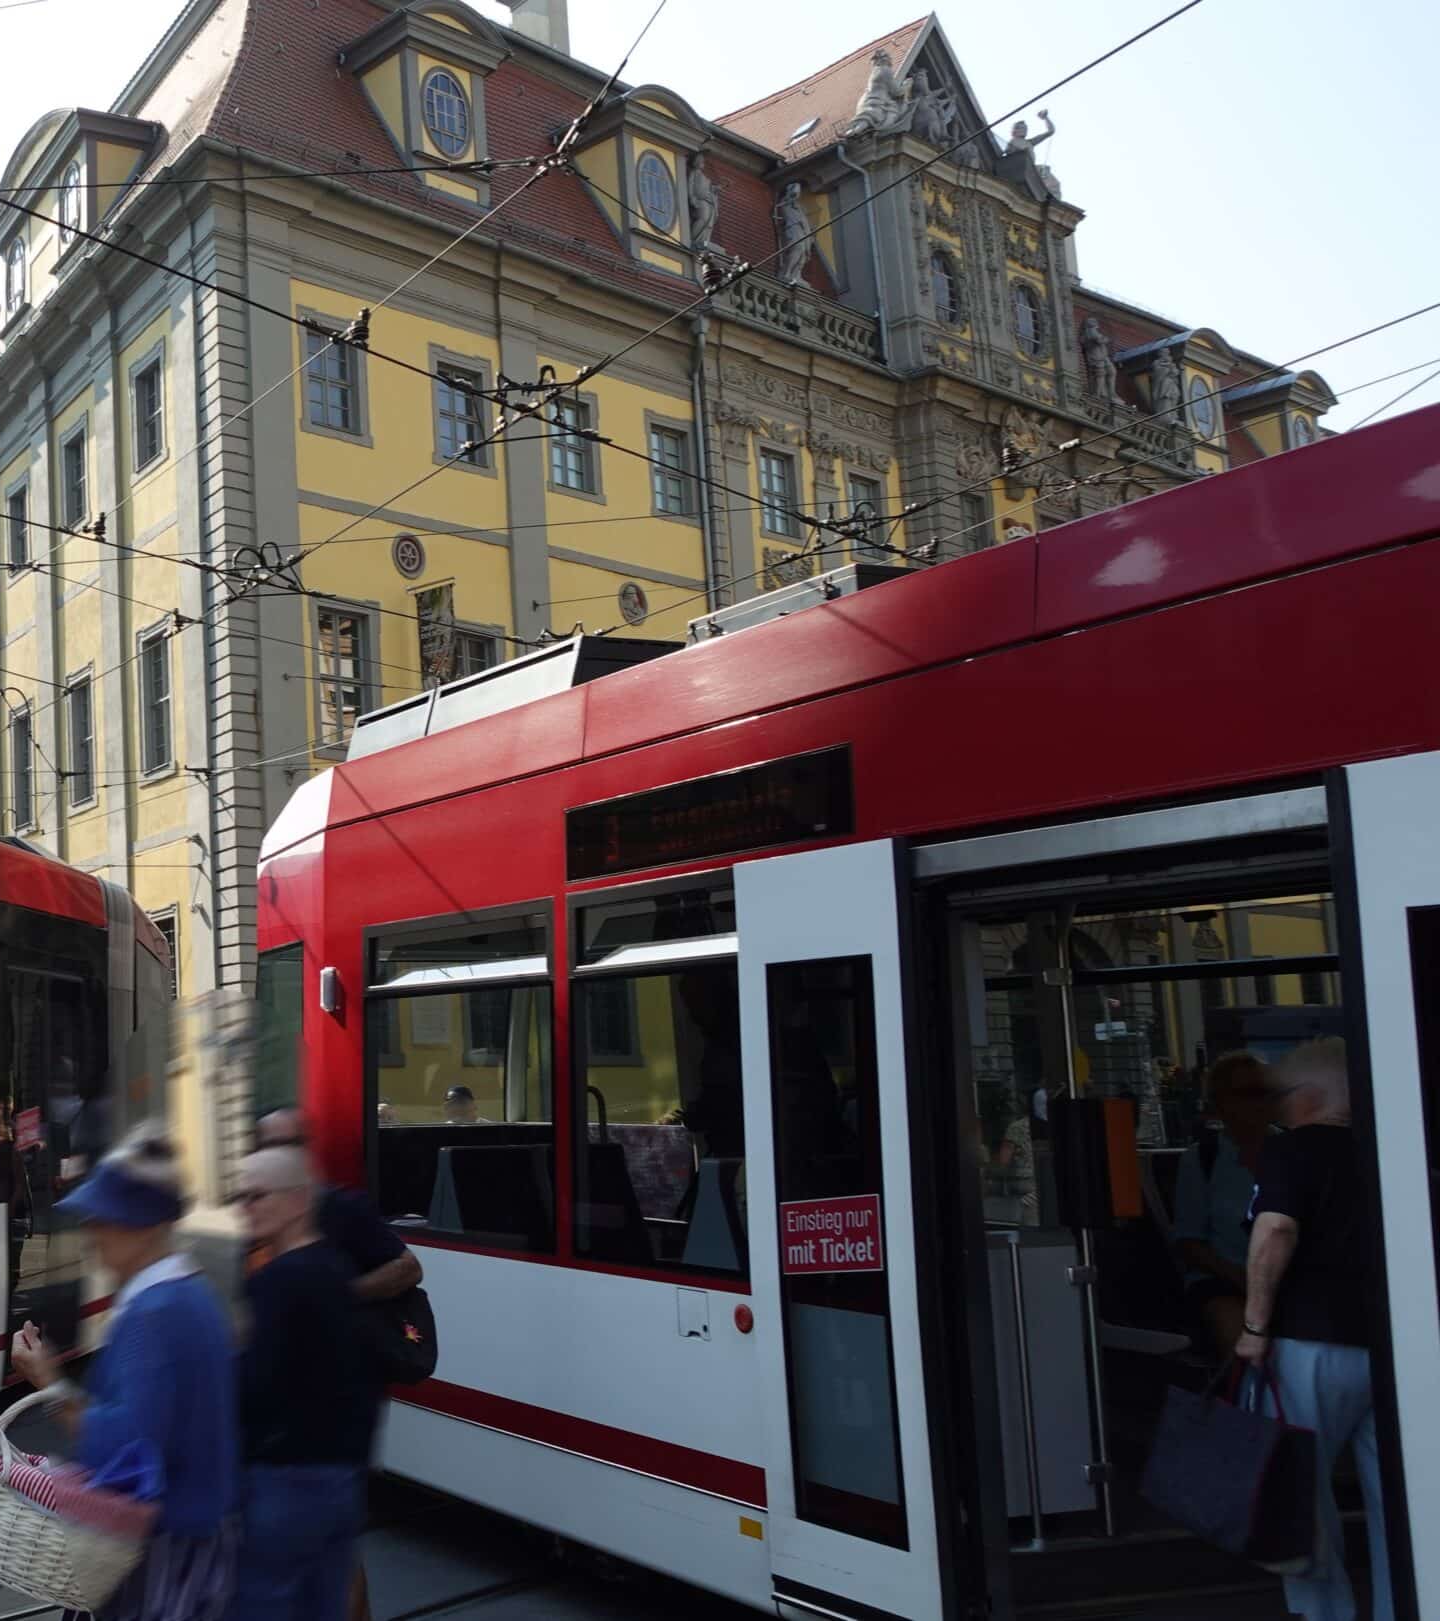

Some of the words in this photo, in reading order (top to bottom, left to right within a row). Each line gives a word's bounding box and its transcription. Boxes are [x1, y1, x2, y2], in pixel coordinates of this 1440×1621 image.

[786, 1209, 843, 1235] Einstieg
[845, 1210, 872, 1228] nur
[788, 1240, 816, 1265] mit
[819, 1236, 875, 1264] Ticket
